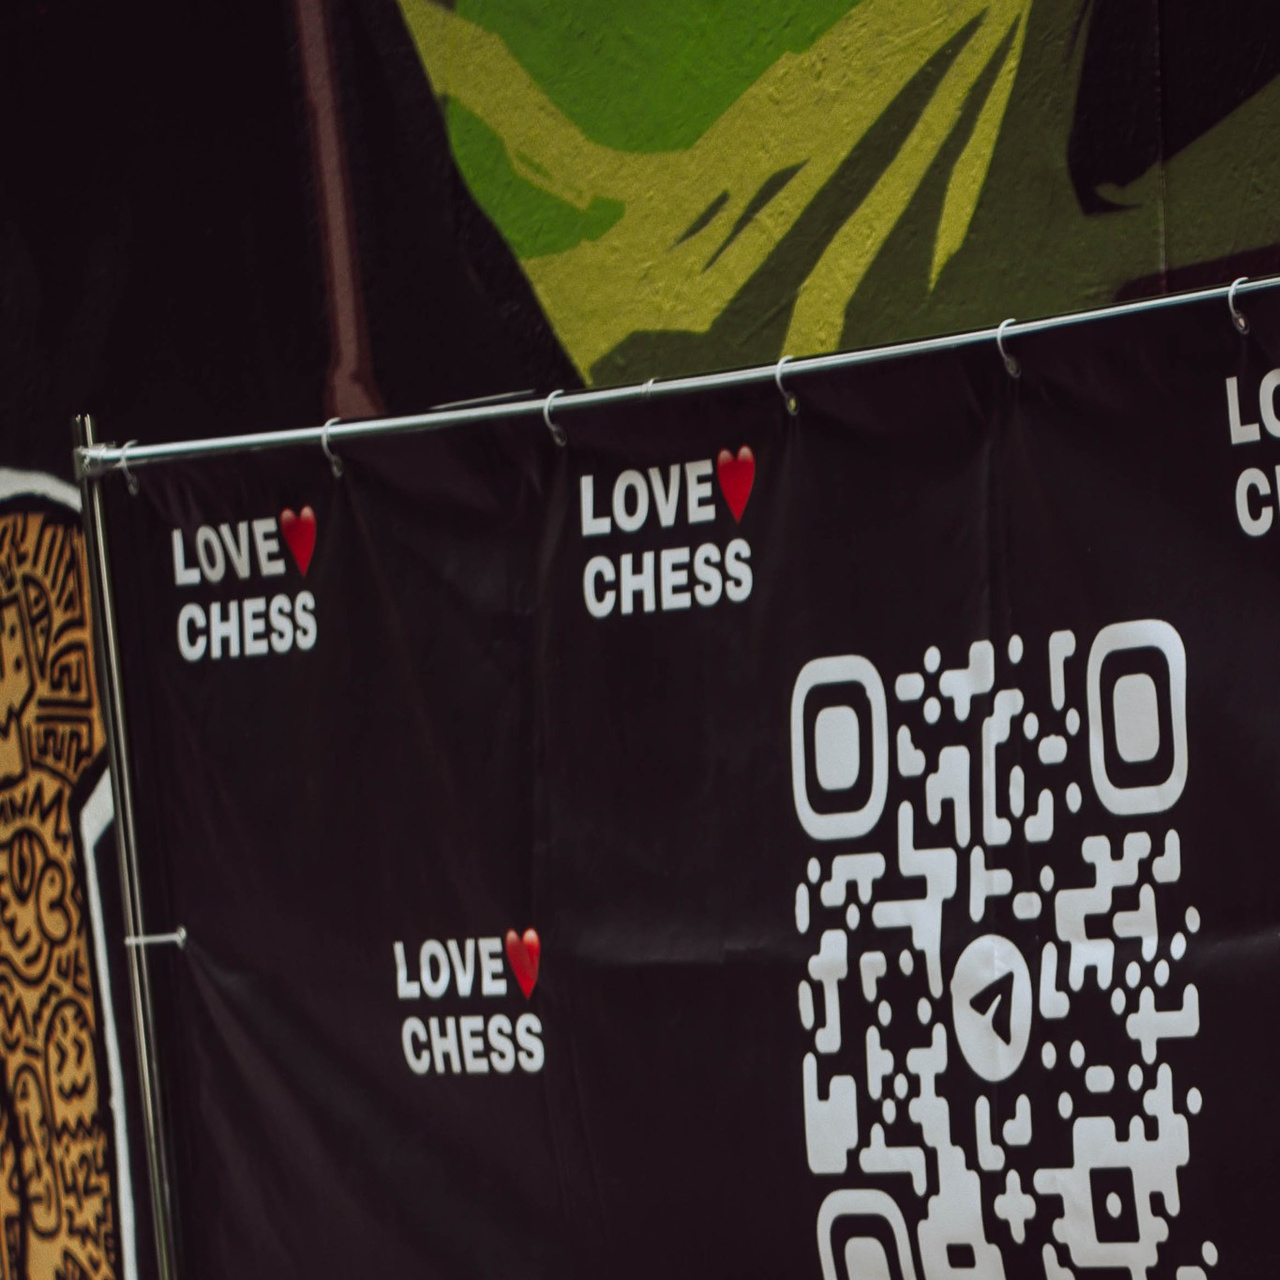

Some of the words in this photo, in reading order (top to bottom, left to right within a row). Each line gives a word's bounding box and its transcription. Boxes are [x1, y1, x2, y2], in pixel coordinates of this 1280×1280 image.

[579, 458, 717, 538] LOVE
[171, 517, 287, 586] LOVE
[582, 537, 754, 619] CHESS
[176, 590, 318, 660] CHESS
[392, 937, 509, 1000] LOVE
[400, 1012, 546, 1076] CHESS
